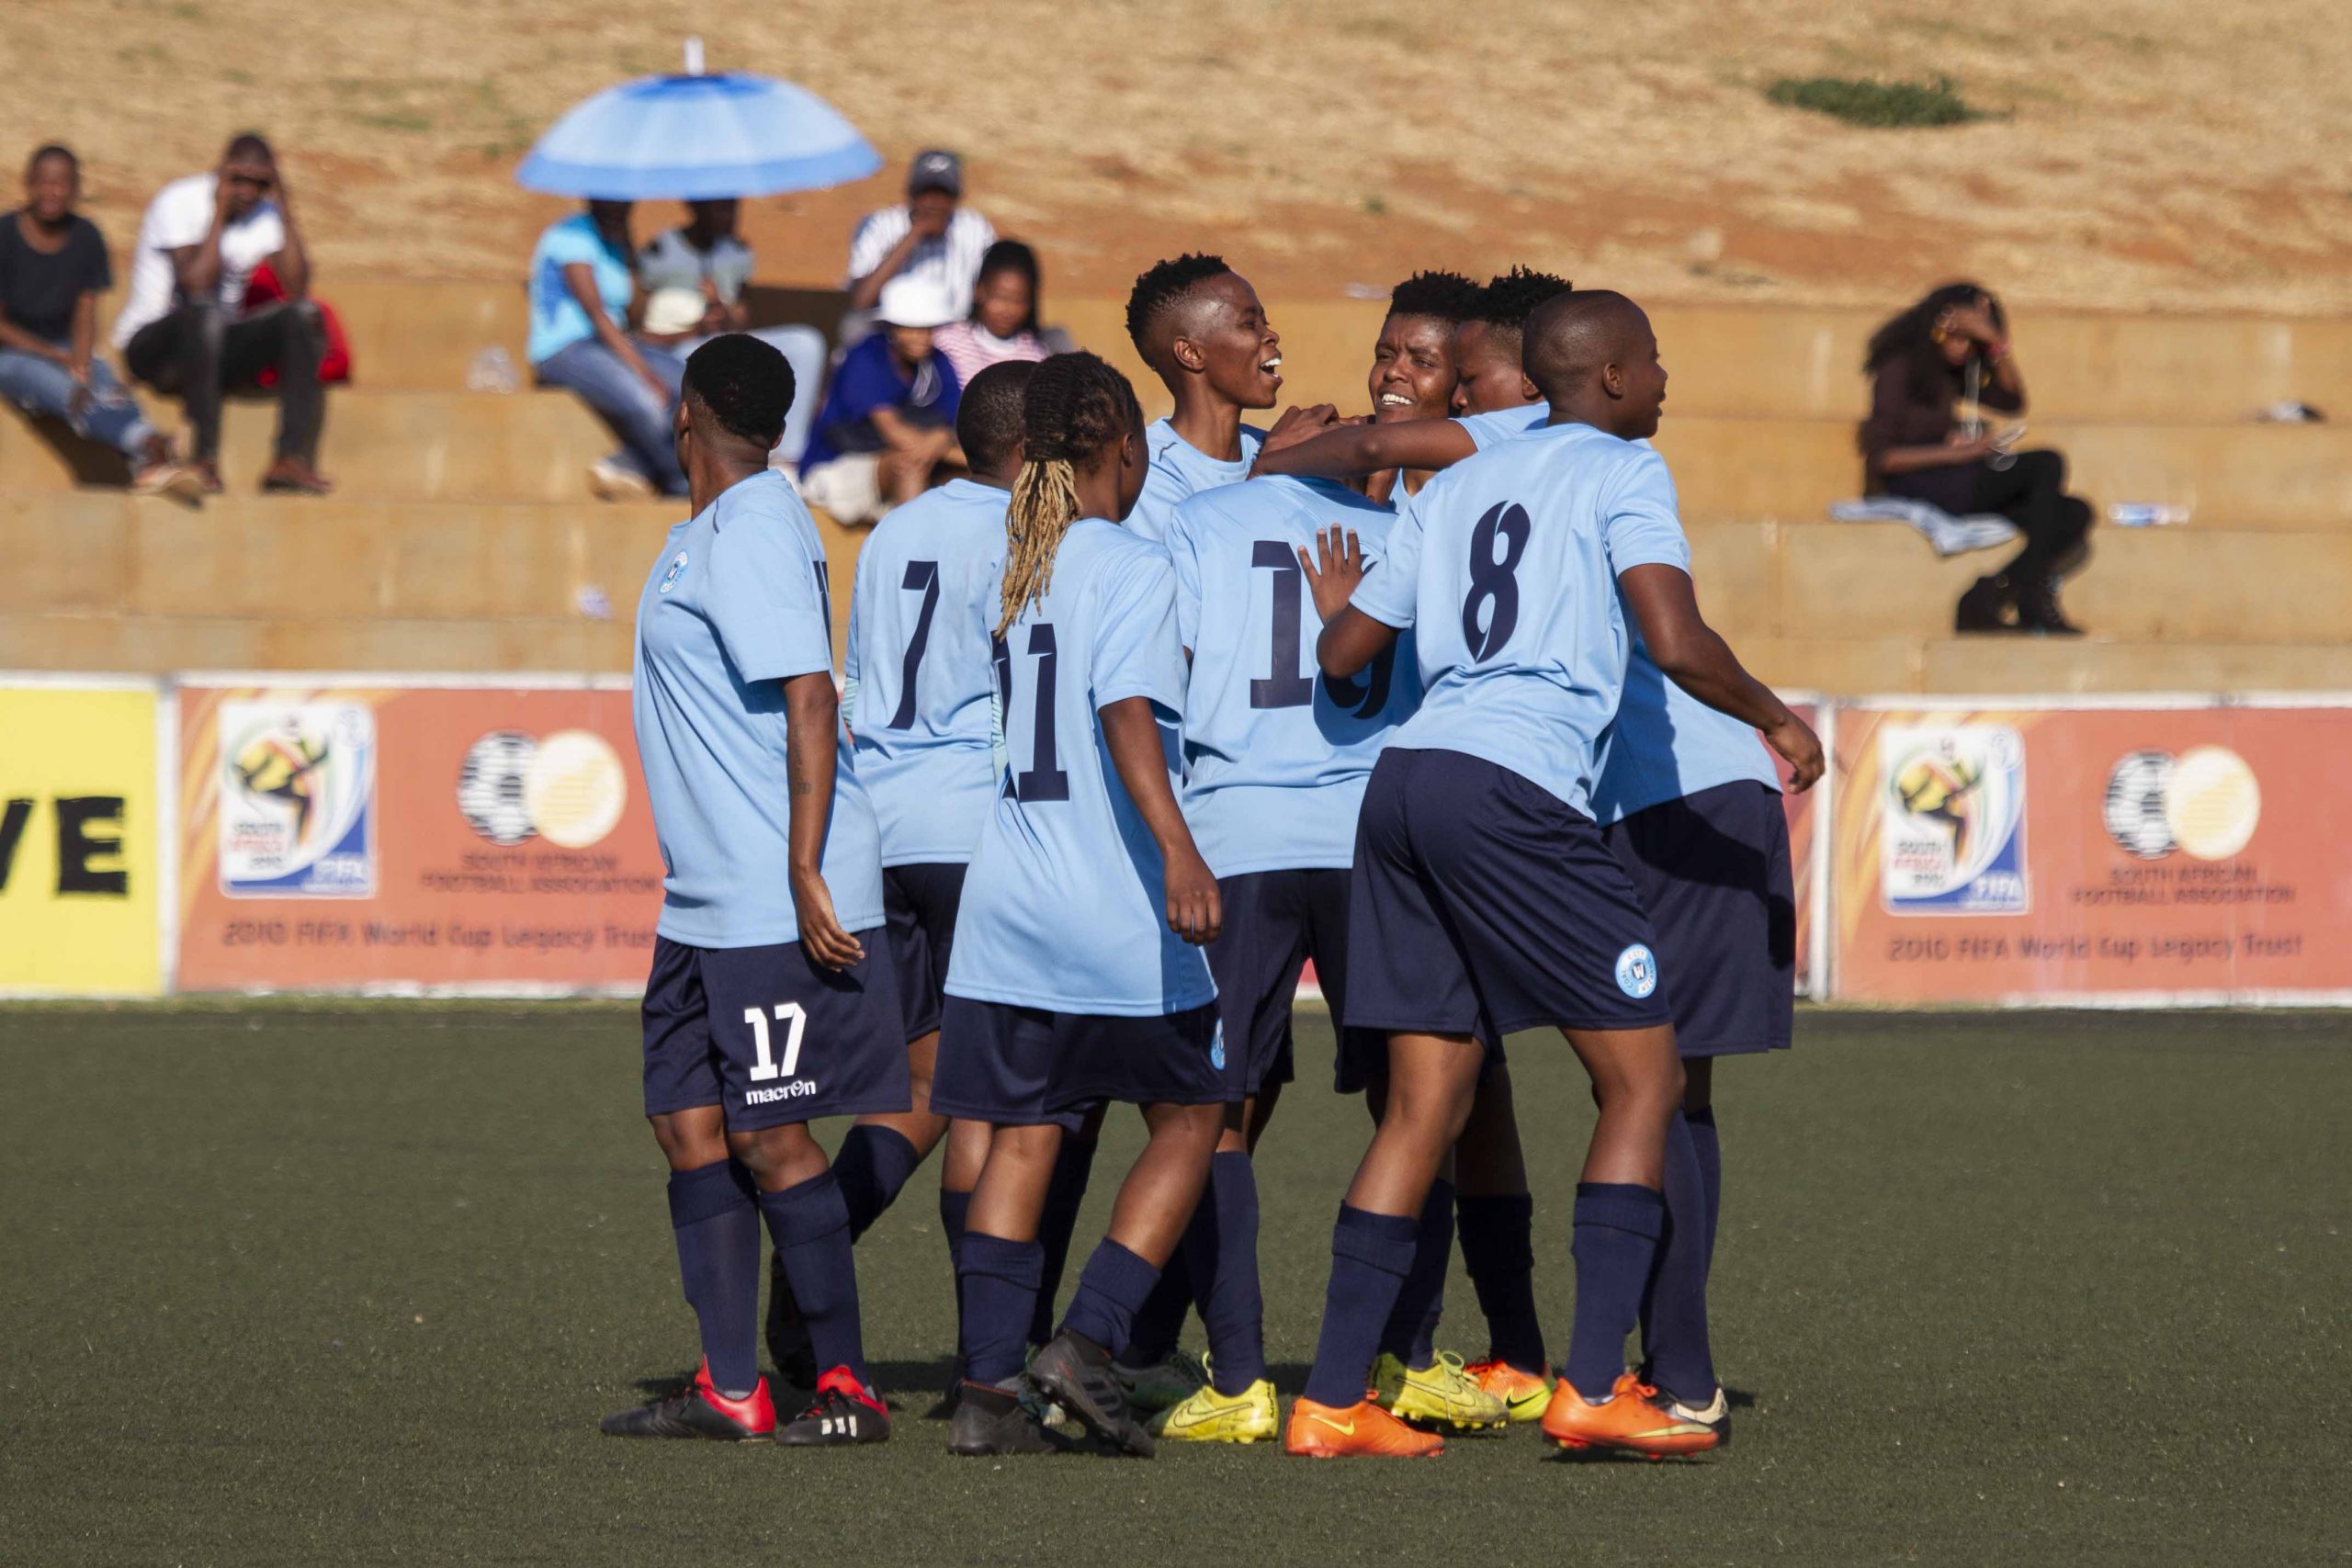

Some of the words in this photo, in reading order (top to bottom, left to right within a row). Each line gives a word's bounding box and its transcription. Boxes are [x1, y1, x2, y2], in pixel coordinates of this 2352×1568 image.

[1464, 501, 1531, 663] 8
[888, 561, 940, 729] 7
[990, 623, 1070, 803] 11
[222, 920, 286, 946] 2010
[364, 920, 437, 946] World
[448, 921, 492, 953] Cup
[502, 922, 594, 953] Legacy
[1889, 936, 1950, 961] 2010
[1958, 936, 2009, 959] FIFA
[2019, 935, 2091, 960] World
[2098, 935, 2139, 964] Cup
[2149, 936, 2237, 964] Legacy
[2244, 932, 2302, 957] Trust
[744, 1000, 807, 1081] 17
[746, 1080, 817, 1106] macron
